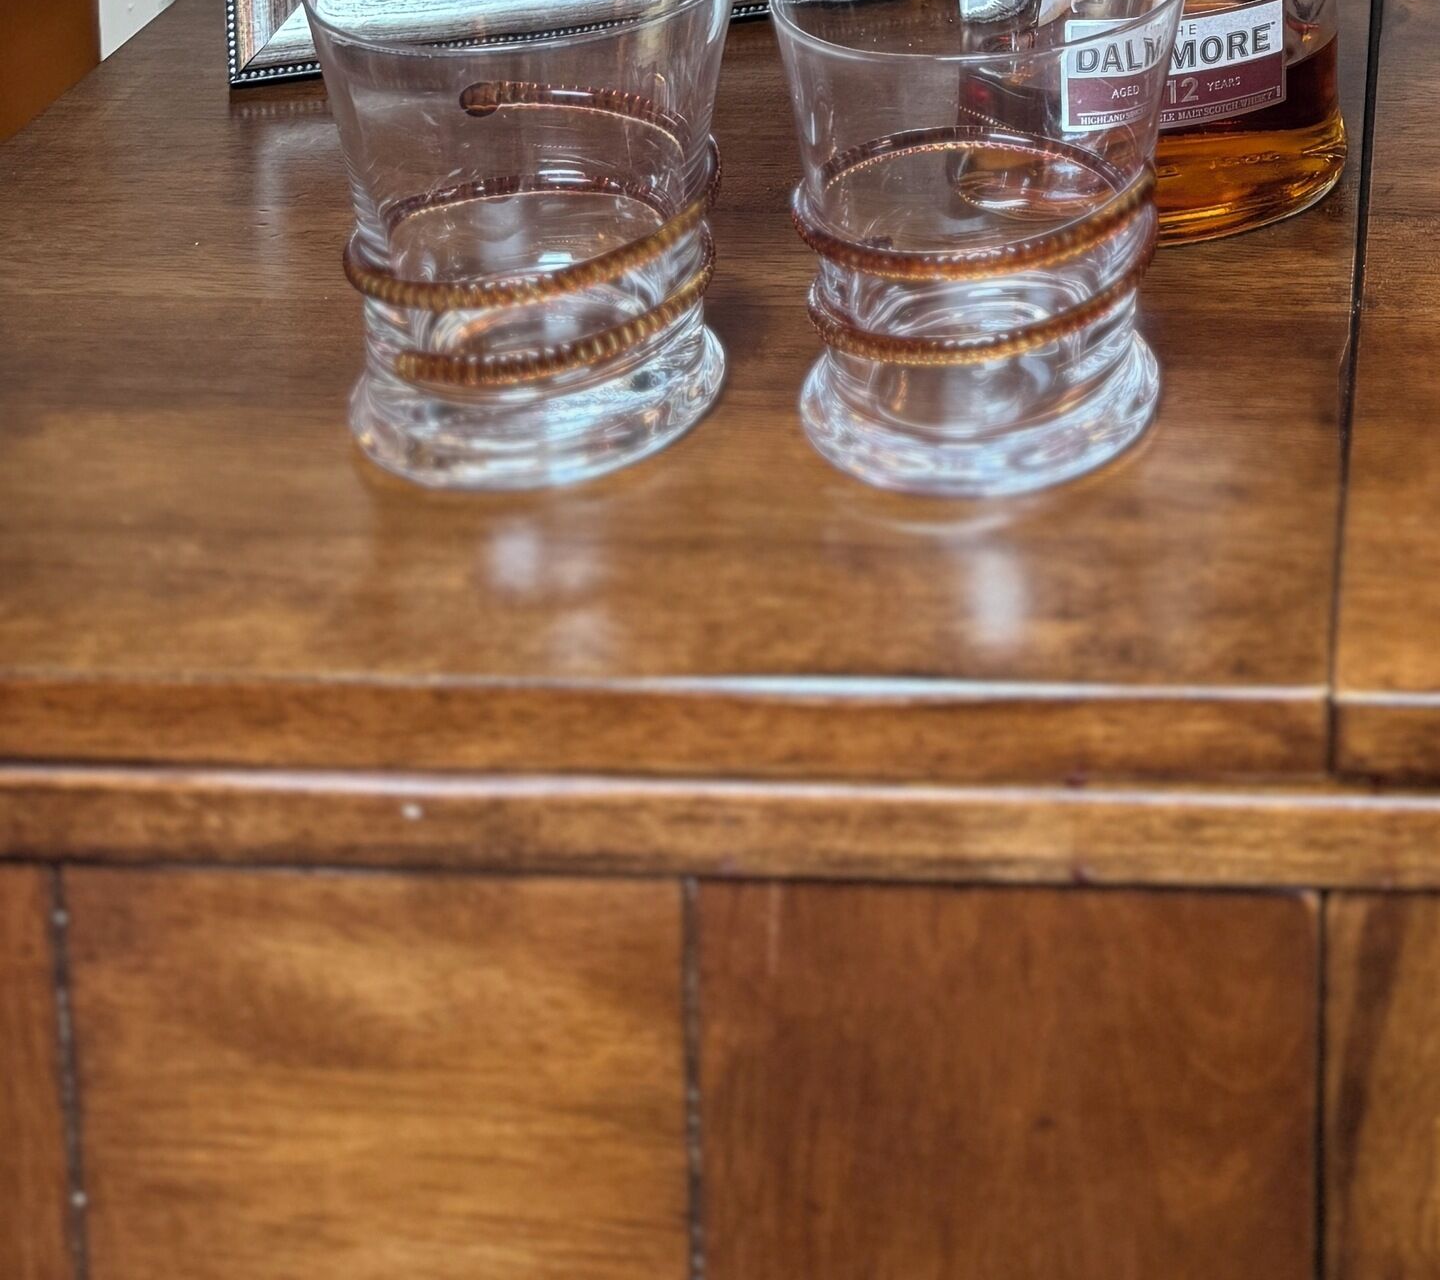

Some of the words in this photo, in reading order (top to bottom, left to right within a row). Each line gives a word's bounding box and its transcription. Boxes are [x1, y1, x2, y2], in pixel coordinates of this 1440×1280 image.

[1110, 84, 1140, 100] AGED
[1165, 76, 1200, 105] 12
[1206, 76, 1242, 93] YEARS
[1080, 112, 1126, 126] HIGHLAND
[1177, 109, 1203, 120] MALT
[1203, 101, 1239, 116] SCOTCH
